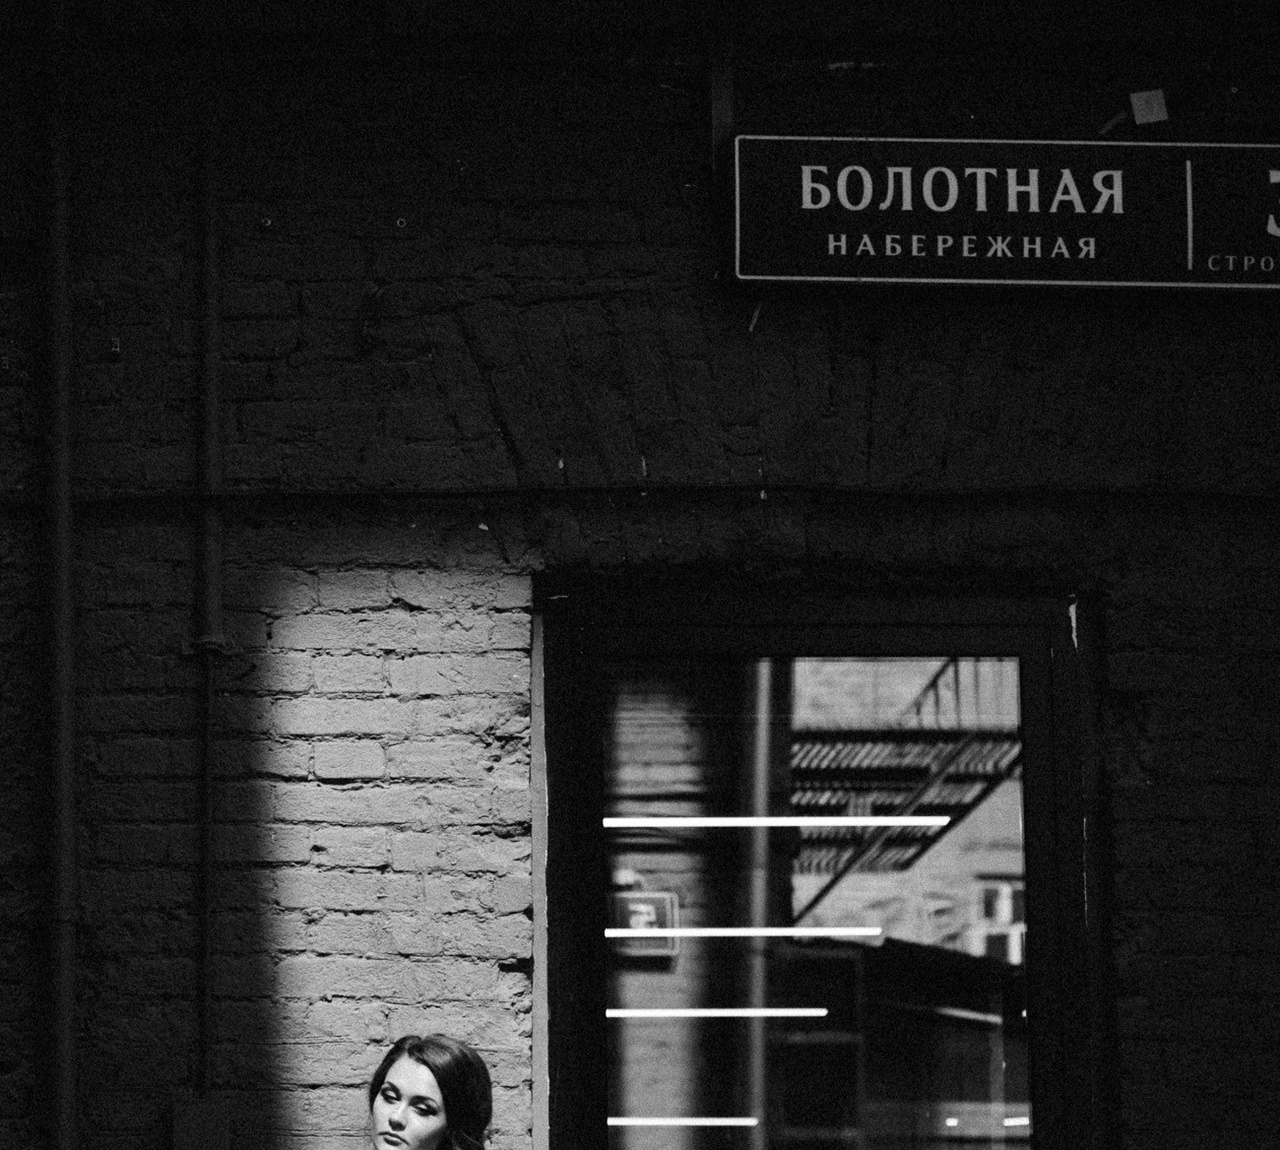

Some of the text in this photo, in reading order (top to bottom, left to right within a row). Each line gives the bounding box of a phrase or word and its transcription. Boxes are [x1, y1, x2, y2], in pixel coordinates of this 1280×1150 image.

[800, 164, 1125, 215] БОЛОТНАЯ
[827, 232, 1098, 260] НАБЕРЕЖНАЯ
[1206, 254, 1276, 272] СТРО
